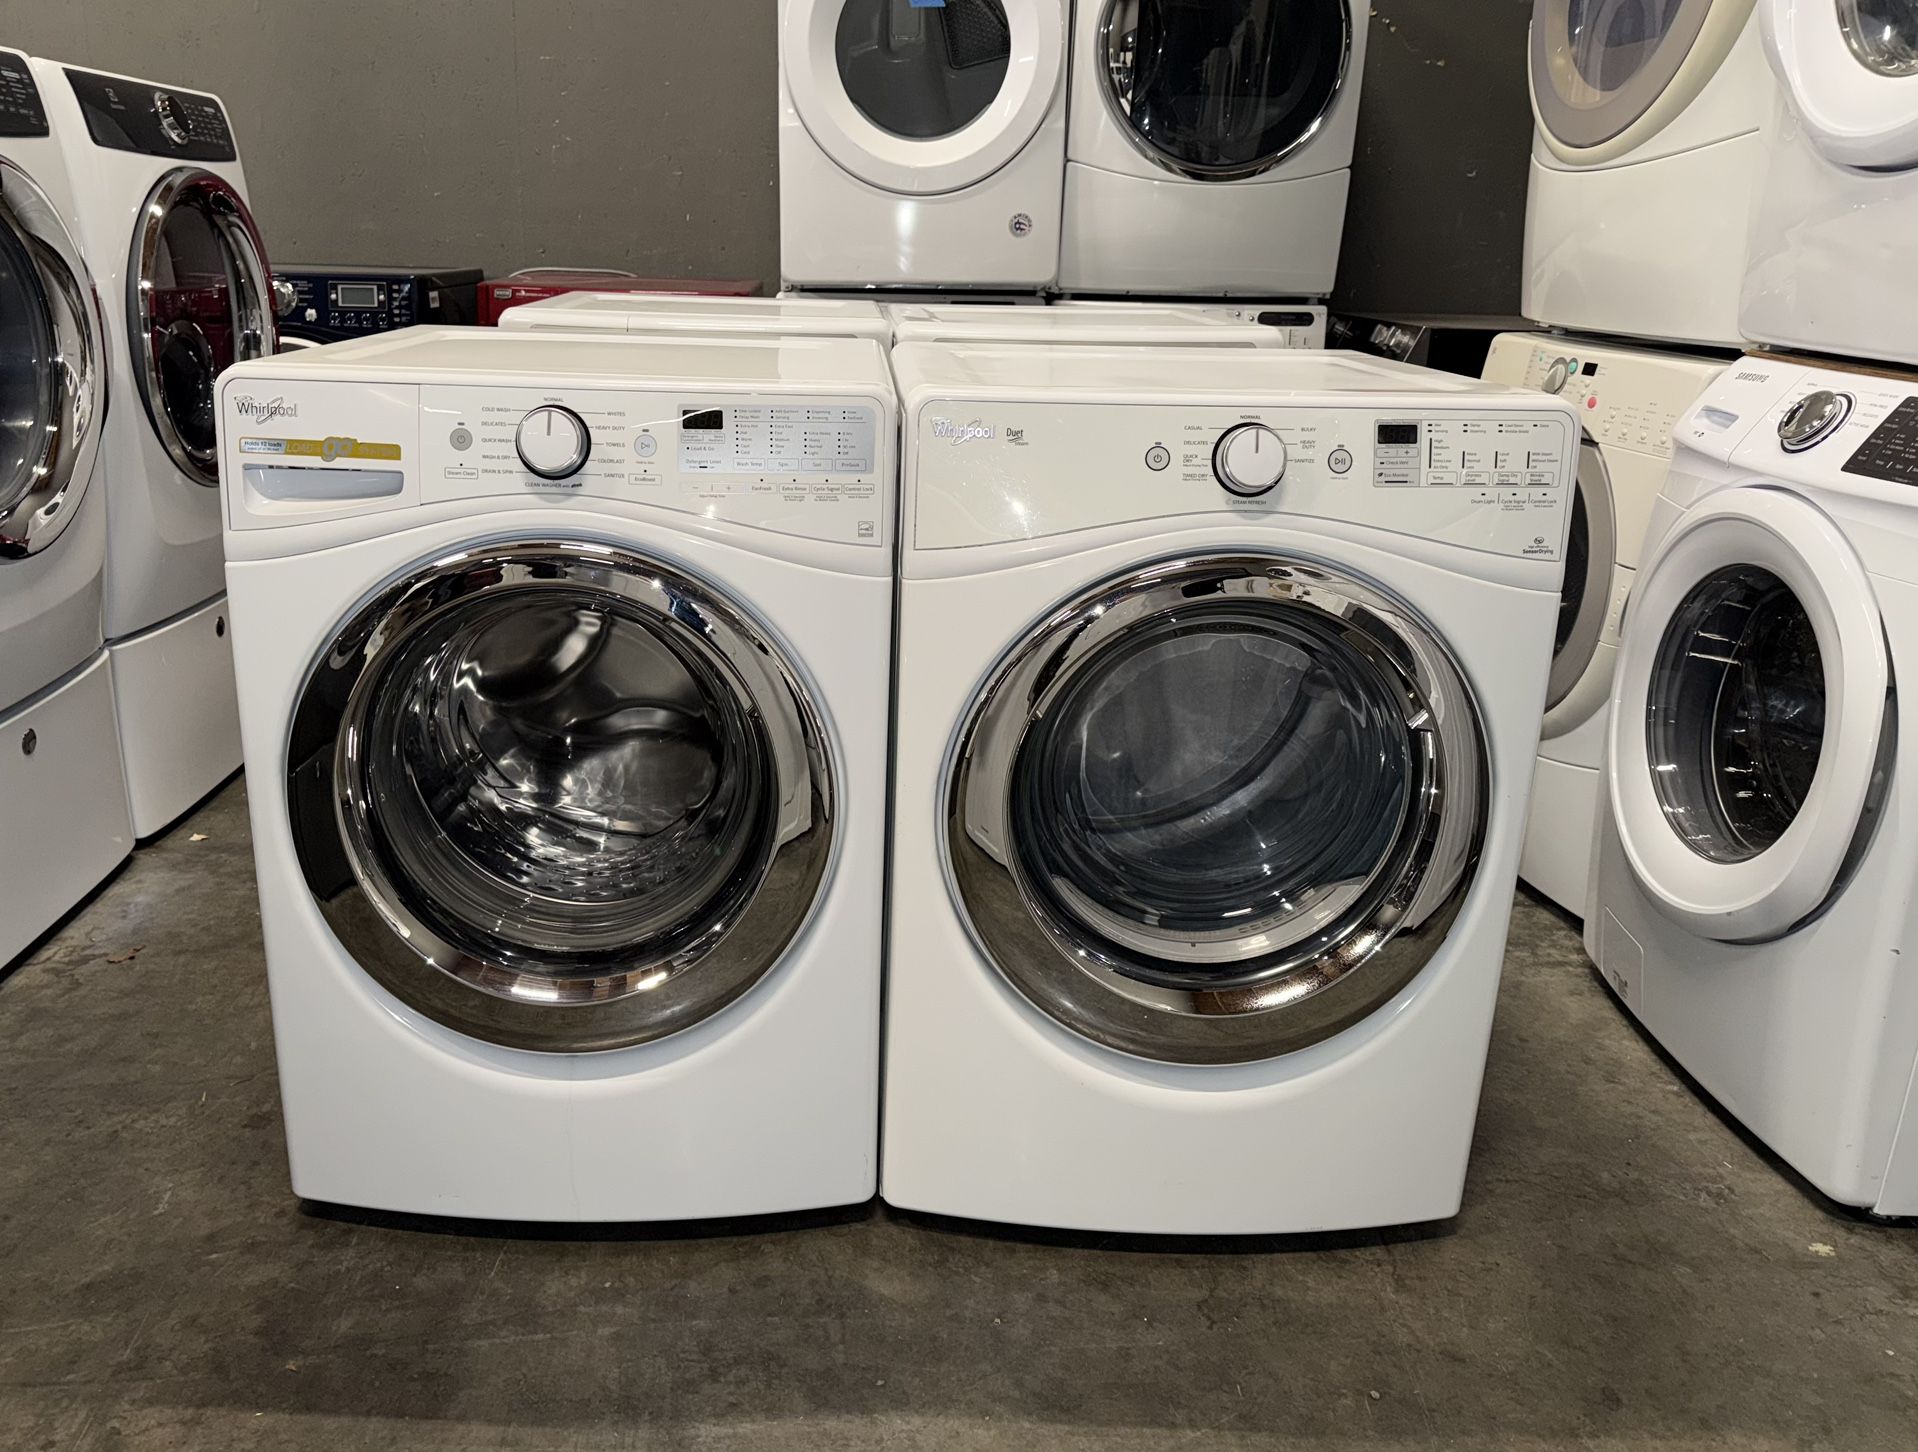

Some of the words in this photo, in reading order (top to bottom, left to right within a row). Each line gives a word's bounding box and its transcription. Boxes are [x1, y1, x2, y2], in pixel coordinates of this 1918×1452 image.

[1735, 372, 1770, 383] SAMSUNG
[236, 400, 298, 420] Whirlpool
[932, 420, 996, 440] Whirlpool
[1006, 427, 1024, 437] Duet
